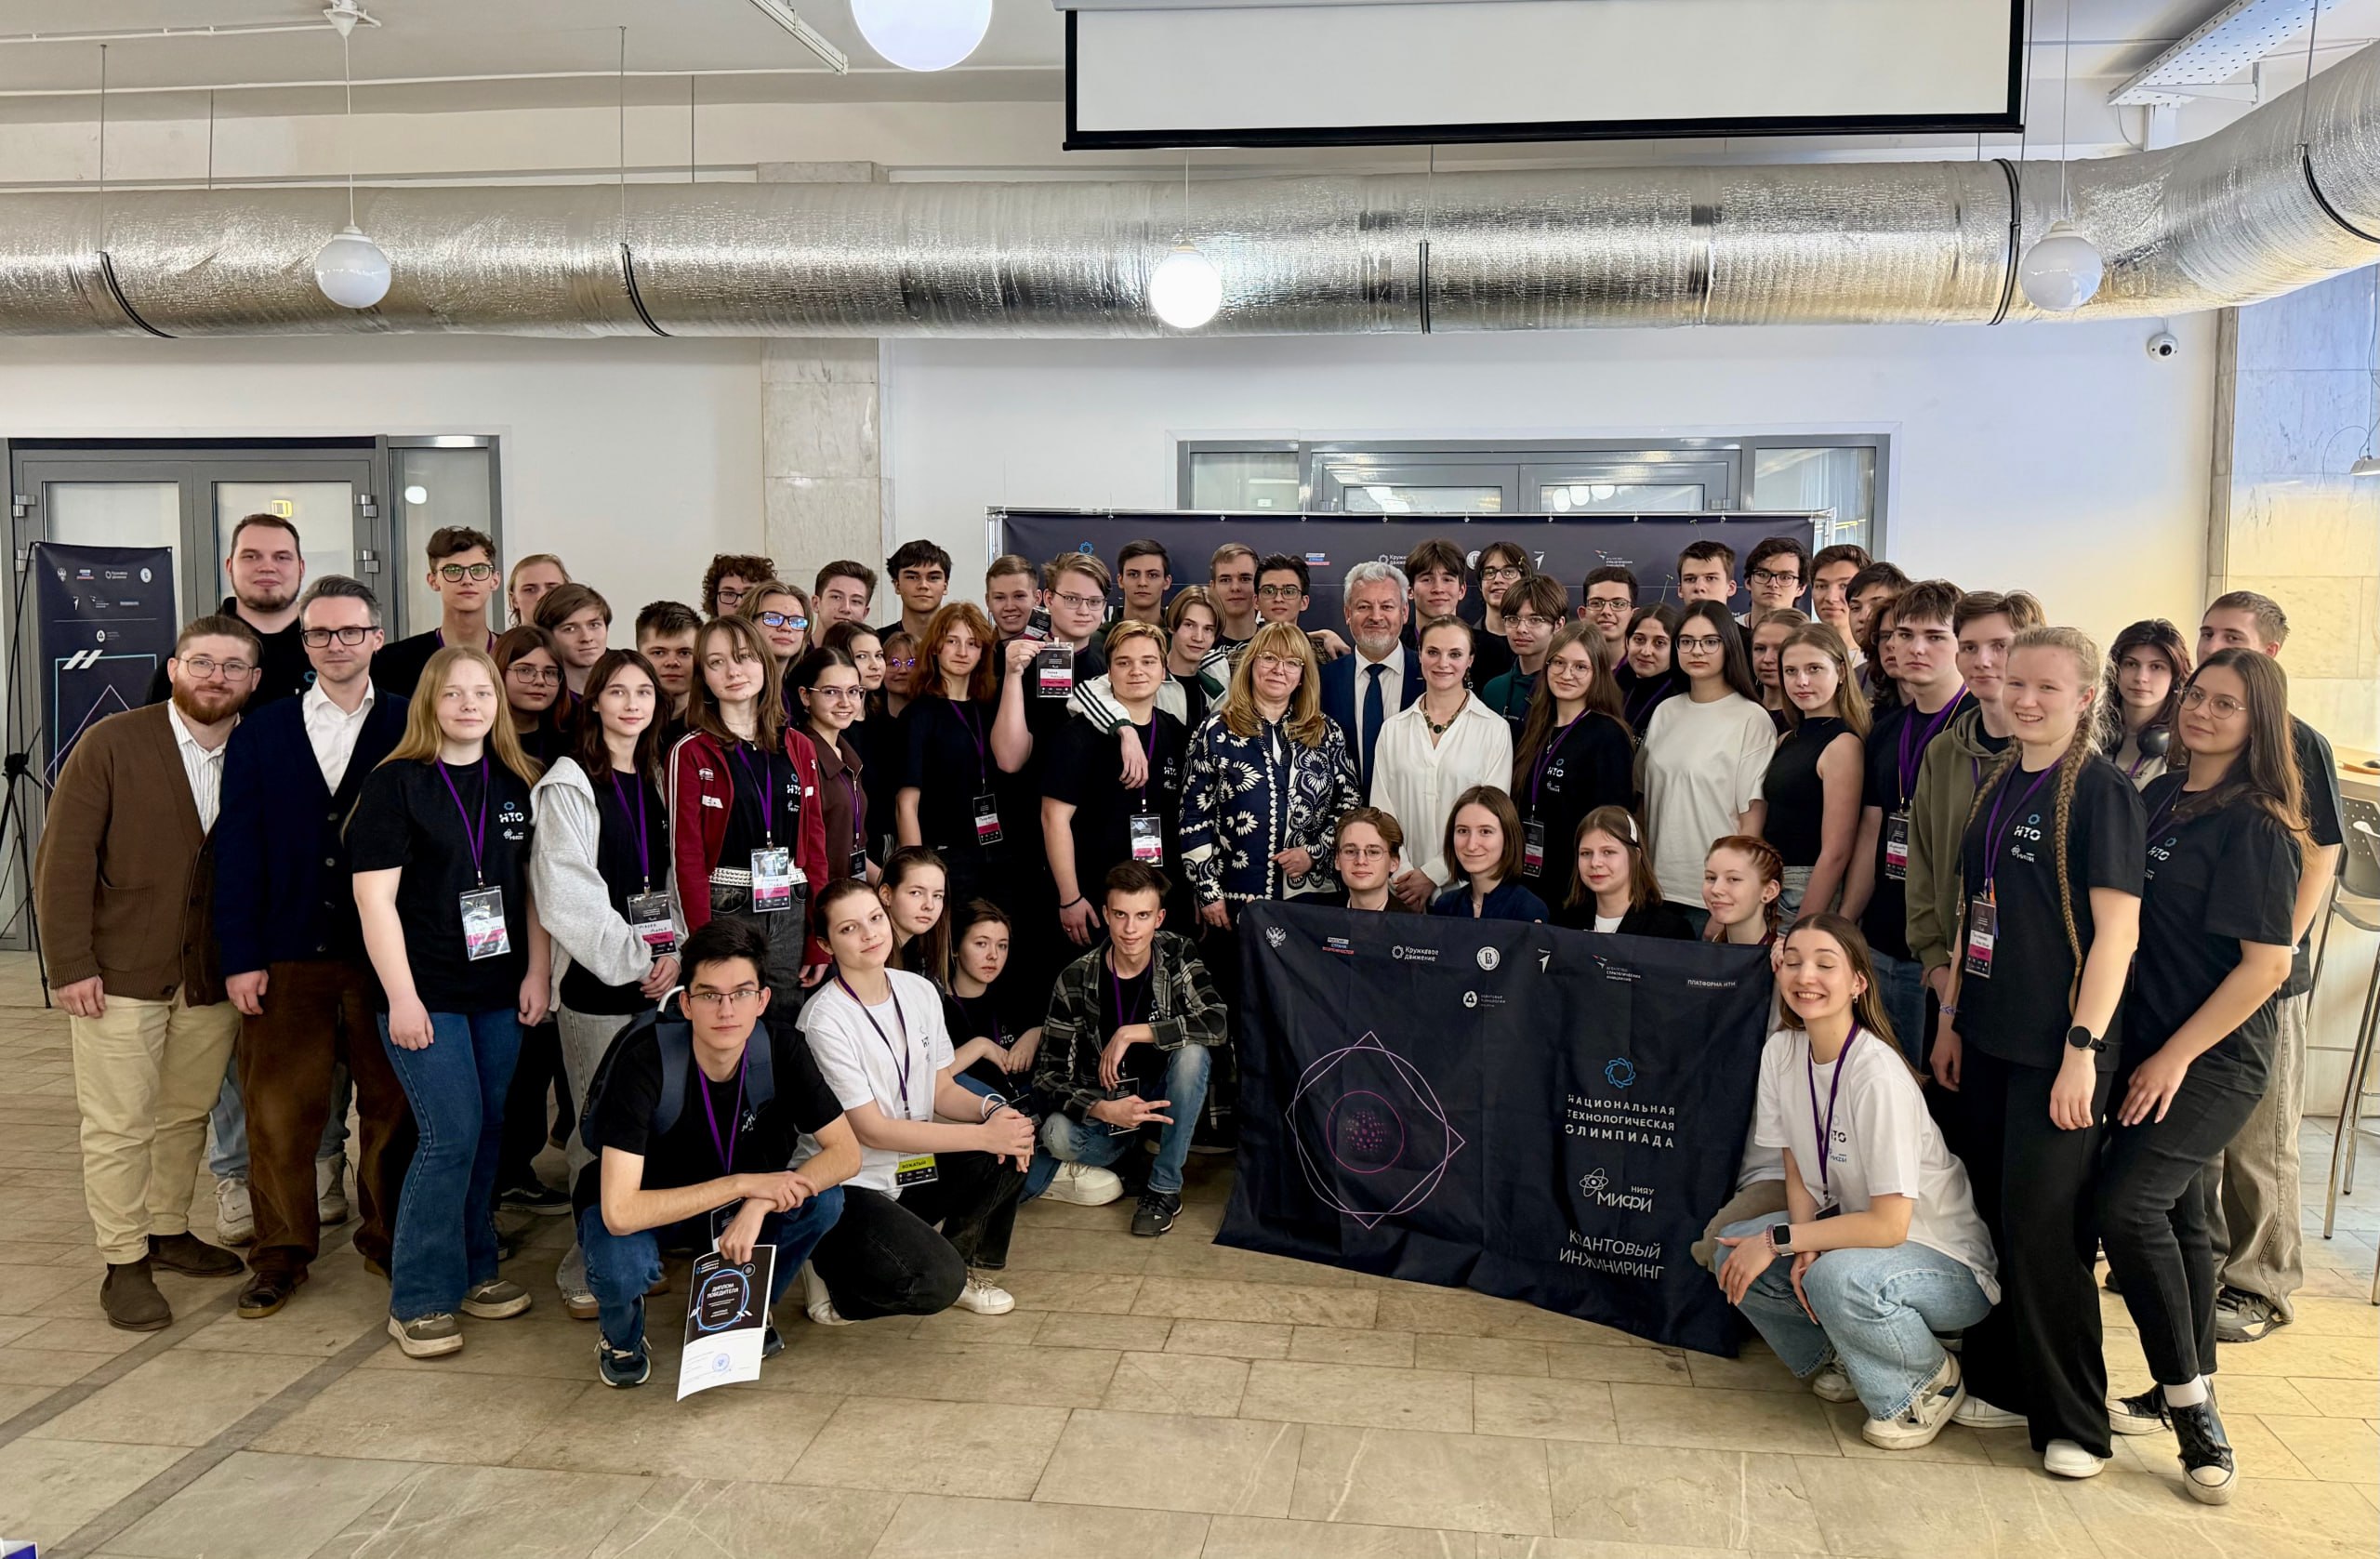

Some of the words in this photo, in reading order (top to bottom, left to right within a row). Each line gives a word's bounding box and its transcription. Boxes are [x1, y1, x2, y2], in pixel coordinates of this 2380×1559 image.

[498, 812, 524, 824] НТО
[2013, 825, 2042, 841] НТО
[1567, 1093, 1675, 1116] НАЦИОНАЛЬНАЯ
[1567, 1108, 1675, 1131] ТЕХНОЛОГИЧЕСКАЯ
[1565, 1123, 1674, 1149] ОЛИМПИАДА
[1631, 1185, 1655, 1196] НИЯУ
[1596, 1191, 1653, 1213] МИФИ
